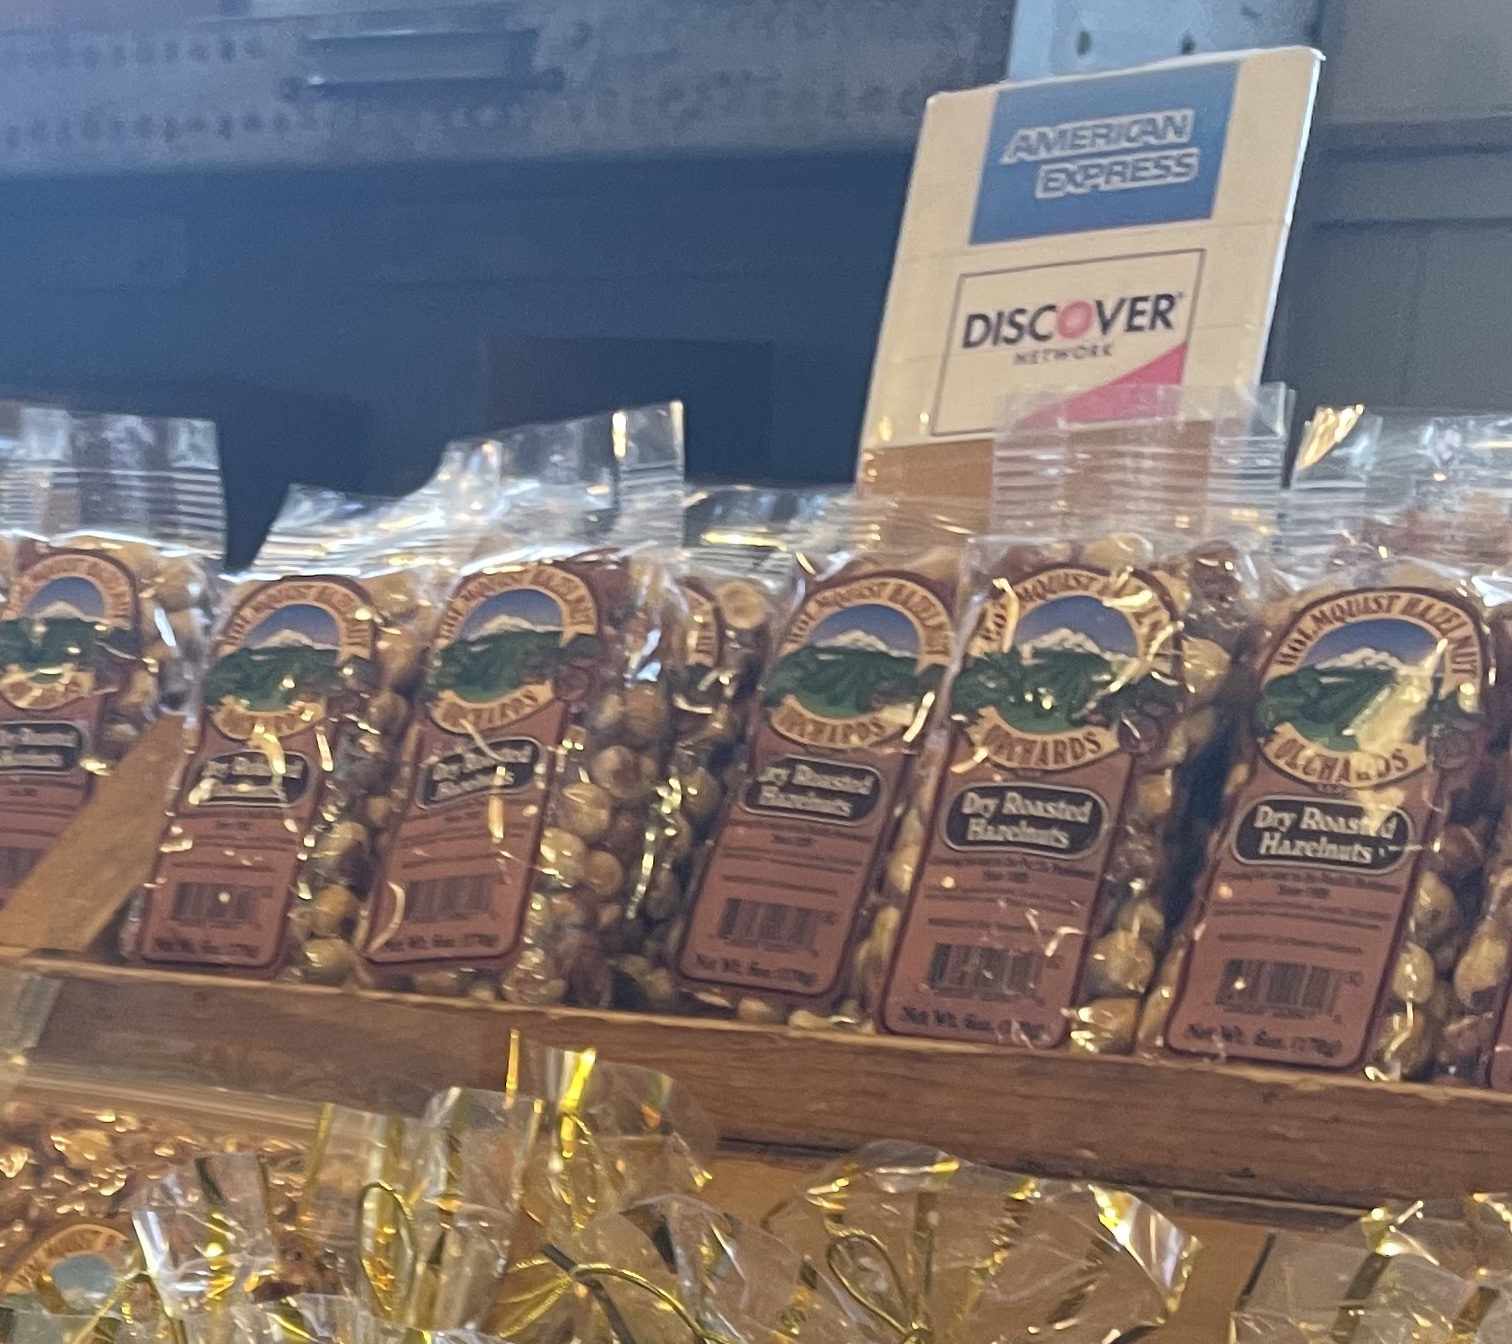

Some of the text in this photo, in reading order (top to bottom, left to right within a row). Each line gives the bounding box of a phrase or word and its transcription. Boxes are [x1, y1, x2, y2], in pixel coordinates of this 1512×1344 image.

[1000, 110, 1193, 163] AMERICAN
[1036, 148, 1198, 198] EXPRESS
[962, 293, 1176, 348] DISCOVER
[1013, 342, 1114, 366] NETWORK
[962, 791, 1093, 823] Dry Roasted
[1254, 805, 1398, 839] Dry Roasd
[1259, 832, 1371, 864] Hazelnuts
